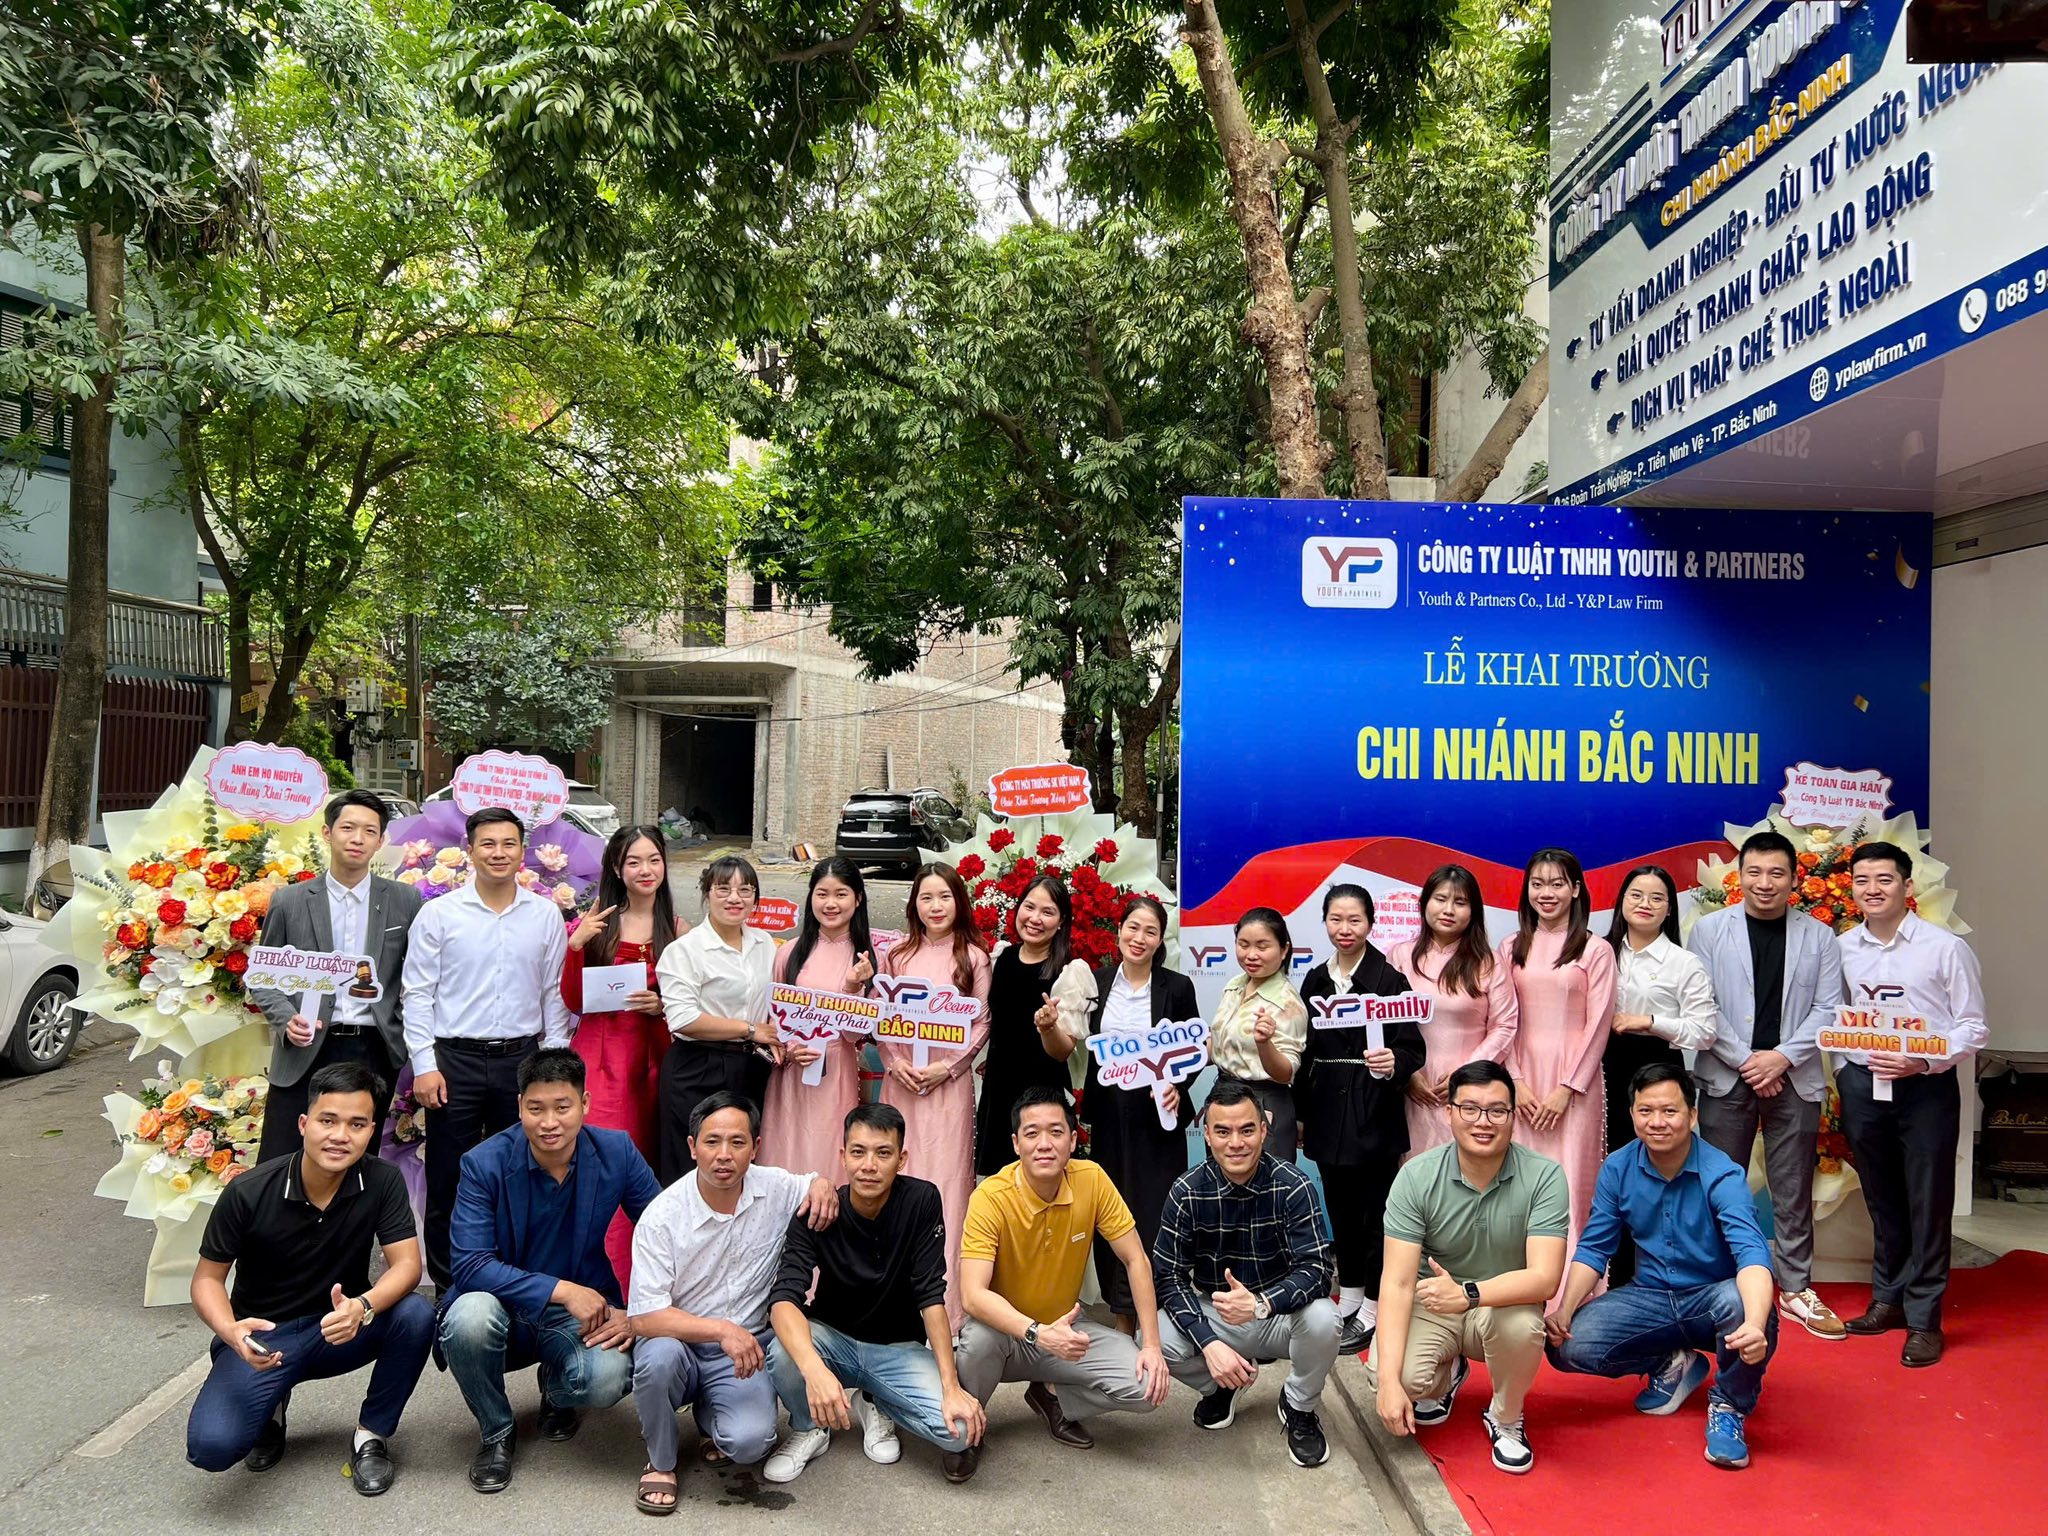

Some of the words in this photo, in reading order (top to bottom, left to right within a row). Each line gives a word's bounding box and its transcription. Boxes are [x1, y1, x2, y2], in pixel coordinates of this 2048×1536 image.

[1660, 185, 1693, 227] CHI
[1692, 135, 1755, 203] NHÁNH
[1754, 95, 1797, 157] BẮC
[1798, 53, 1853, 120] NINH
[1555, 192, 1603, 263] CÔNG
[1600, 167, 1626, 223] TY
[1625, 119, 1679, 202] LUẬT
[1678, 57, 1748, 154] TNHH
[1589, 310, 1606, 351] TƯ
[1608, 288, 1634, 334] VẤN
[1637, 253, 1687, 317] DOANH
[1689, 208, 1750, 281] NGHIỆP
[1765, 162, 1805, 228] ĐẦU
[1810, 135, 1840, 193] TƯ
[1845, 88, 1908, 170] NƯỚC
[1616, 333, 1644, 383] GIẢI
[1646, 302, 1692, 367] QUYẾT
[1697, 270, 1753, 333] TRANH
[1759, 224, 1810, 296] CHẤP
[1817, 201, 1857, 260] LAO
[1865, 151, 1934, 228] ĐỘNG
[1995, 279, 2028, 312] 088
[1631, 385, 1664, 432] DỊCH
[1667, 374, 1687, 412] VỤ
[1690, 344, 1733, 399] PHÁP
[1738, 308, 1777, 372] CHẾ
[1780, 282, 1831, 349] THUÊ
[1839, 240, 1912, 318] NGOÀI
[1834, 331, 1927, 391] yplawfirm.vn
[1590, 479, 1606, 498] Trần
[1607, 470, 1632, 492] Nghiệp
[1638, 462, 1646, 477] P.
[1669, 443, 1688, 463] Ninh
[1691, 433, 1704, 454] Vệ
[1711, 424, 1727, 444] TP.
[1730, 410, 1750, 436] Bắc
[1752, 400, 1777, 425] Ninh
[1418, 539, 1472, 573] CÔNG
[1478, 546, 1501, 574] TY
[1507, 541, 1555, 581] LUẬT
[1560, 548, 1611, 576] TNHH
[1617, 549, 1677, 578] YOUTH
[1684, 551, 1698, 578] &
[1706, 551, 1804, 580] PARTNERS
[1317, 586, 1343, 596] YOUTH
[1418, 591, 1452, 606] Youth
[1455, 592, 1466, 606] &
[1470, 592, 1516, 607] Partners
[1519, 593, 1543, 609] Co.,
[1546, 593, 1565, 608] Ltd
[1576, 594, 1606, 609] Y&P
[1608, 594, 1632, 609] Law
[1636, 594, 1663, 610] Firm
[1423, 635, 1466, 685] LỄ
[1475, 653, 1560, 687] KHAI
[1569, 651, 1710, 689] TRƯƠNG
[1357, 726, 1420, 780] CHI
[1433, 717, 1566, 782] NHÁNH
[1579, 709, 1654, 784] BẮC
[1667, 731, 1759, 785] NINH
[231, 764, 246, 775] ANH
[248, 765, 260, 777] EM
[262, 767, 271, 781] HỌ
[273, 768, 304, 784] NGUYỄN
[1000, 779, 1014, 791] CÔNG
[1014, 779, 1020, 790] TY
[1058, 774, 1068, 788] VIỆT
[1069, 775, 1080, 787] NAM
[1795, 772, 1808, 785] KẾ
[1840, 780, 1857, 791] GIA
[219, 778, 237, 794] Chúc
[239, 781, 261, 799] Mừng
[262, 784, 282, 800] Khai
[284, 787, 311, 807] Trương
[1801, 792, 1817, 804] Công
[1819, 795, 1827, 806] Ty
[1869, 800, 1884, 810] Ninh
[762, 915, 786, 928] Mừng
[254, 950, 304, 968] PHÁP
[306, 955, 356, 975] LUẬT
[772, 986, 811, 1006] KHAI
[815, 993, 880, 1018] TRƯƠNG
[1365, 996, 1430, 1020] Family
[790, 1006, 834, 1027] Hồng
[835, 1013, 870, 1030] Phát
[878, 1015, 915, 1037] BẮC
[919, 1023, 964, 1042] NINH
[1893, 1016, 1927, 1031] ra
[1091, 1036, 1140, 1060] Tỏa
[1820, 1031, 1901, 1052] CHƯƠNG
[1906, 1035, 1947, 1055] MỚI
[1103, 1062, 1138, 1084] cùng
